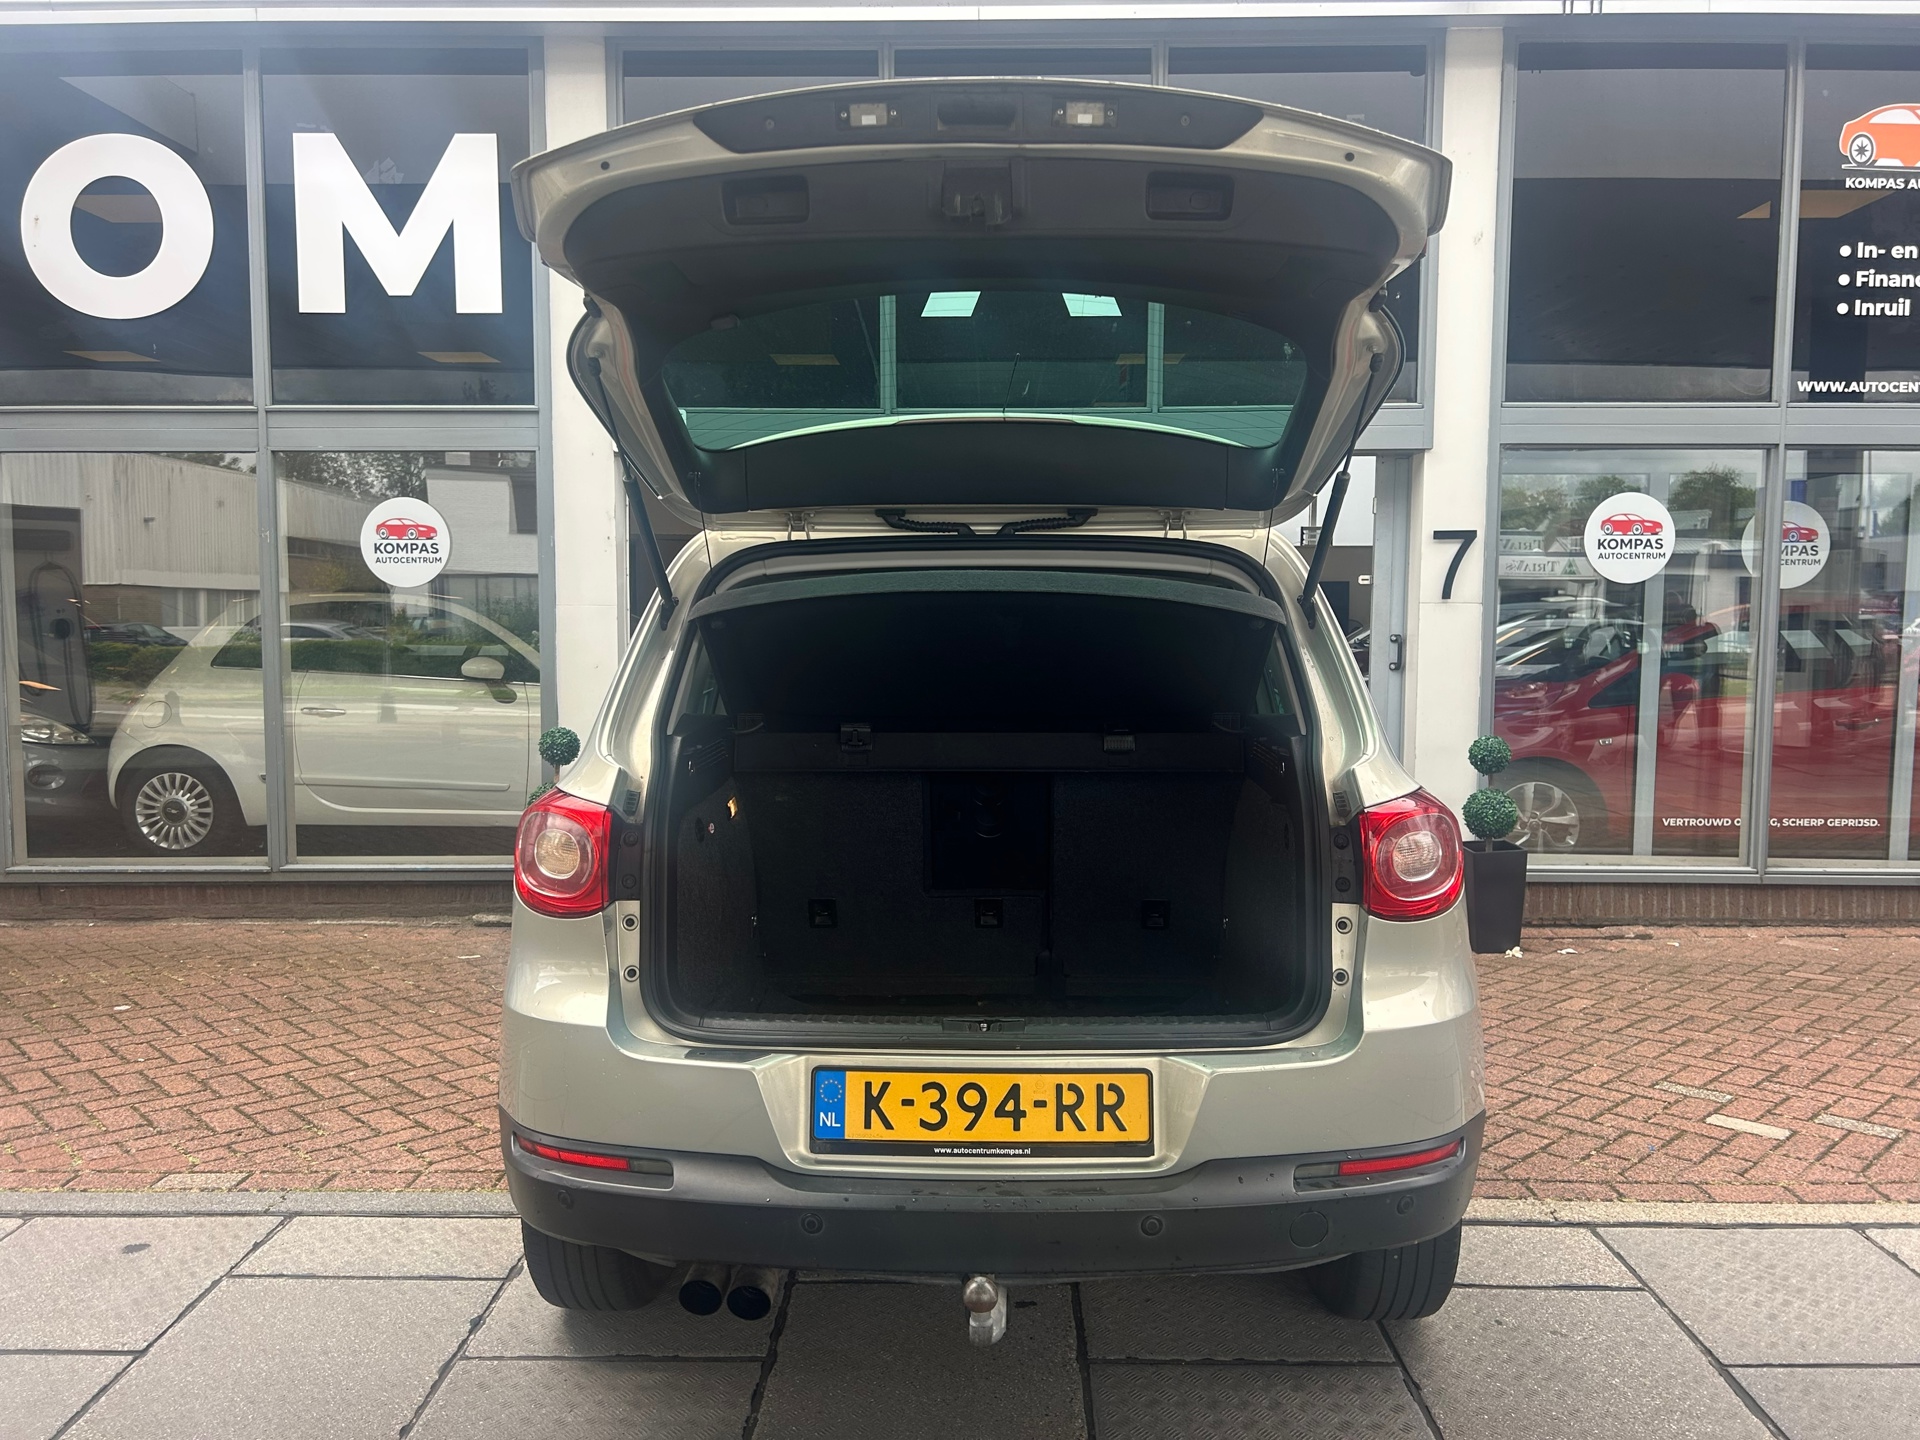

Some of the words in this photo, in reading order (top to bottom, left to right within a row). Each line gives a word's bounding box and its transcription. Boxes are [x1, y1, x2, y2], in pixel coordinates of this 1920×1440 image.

[1845, 177, 1905, 190] KOMPAS
[1907, 177, 1920, 190] A
[1857, 241, 1886, 259] In-
[1891, 245, 1918, 259] en
[1854, 297, 1911, 316] Inruil
[1797, 381, 1920, 393] WWW.AUTOCEN
[374, 542, 440, 554] KOMPAS
[1597, 538, 1664, 550] KOMPAS
[1597, 552, 1666, 560] AUTOCENTRUM
[1781, 544, 1819, 557] MPAS
[375, 556, 442, 564] AUTOCENTRUM
[1433, 529, 1478, 600] 7
[1780, 558, 1821, 566] CENTRUM
[1662, 817, 1731, 827] VERTROUWD
[1782, 818, 1824, 827] SCHERP
[1827, 818, 1881, 827] GEPRIJSD.
[863, 1080, 1128, 1132] K-394-RR
[819, 1111, 841, 1127] NL
[933, 1147, 1031, 1156] www.autocentrumkompas.nl
